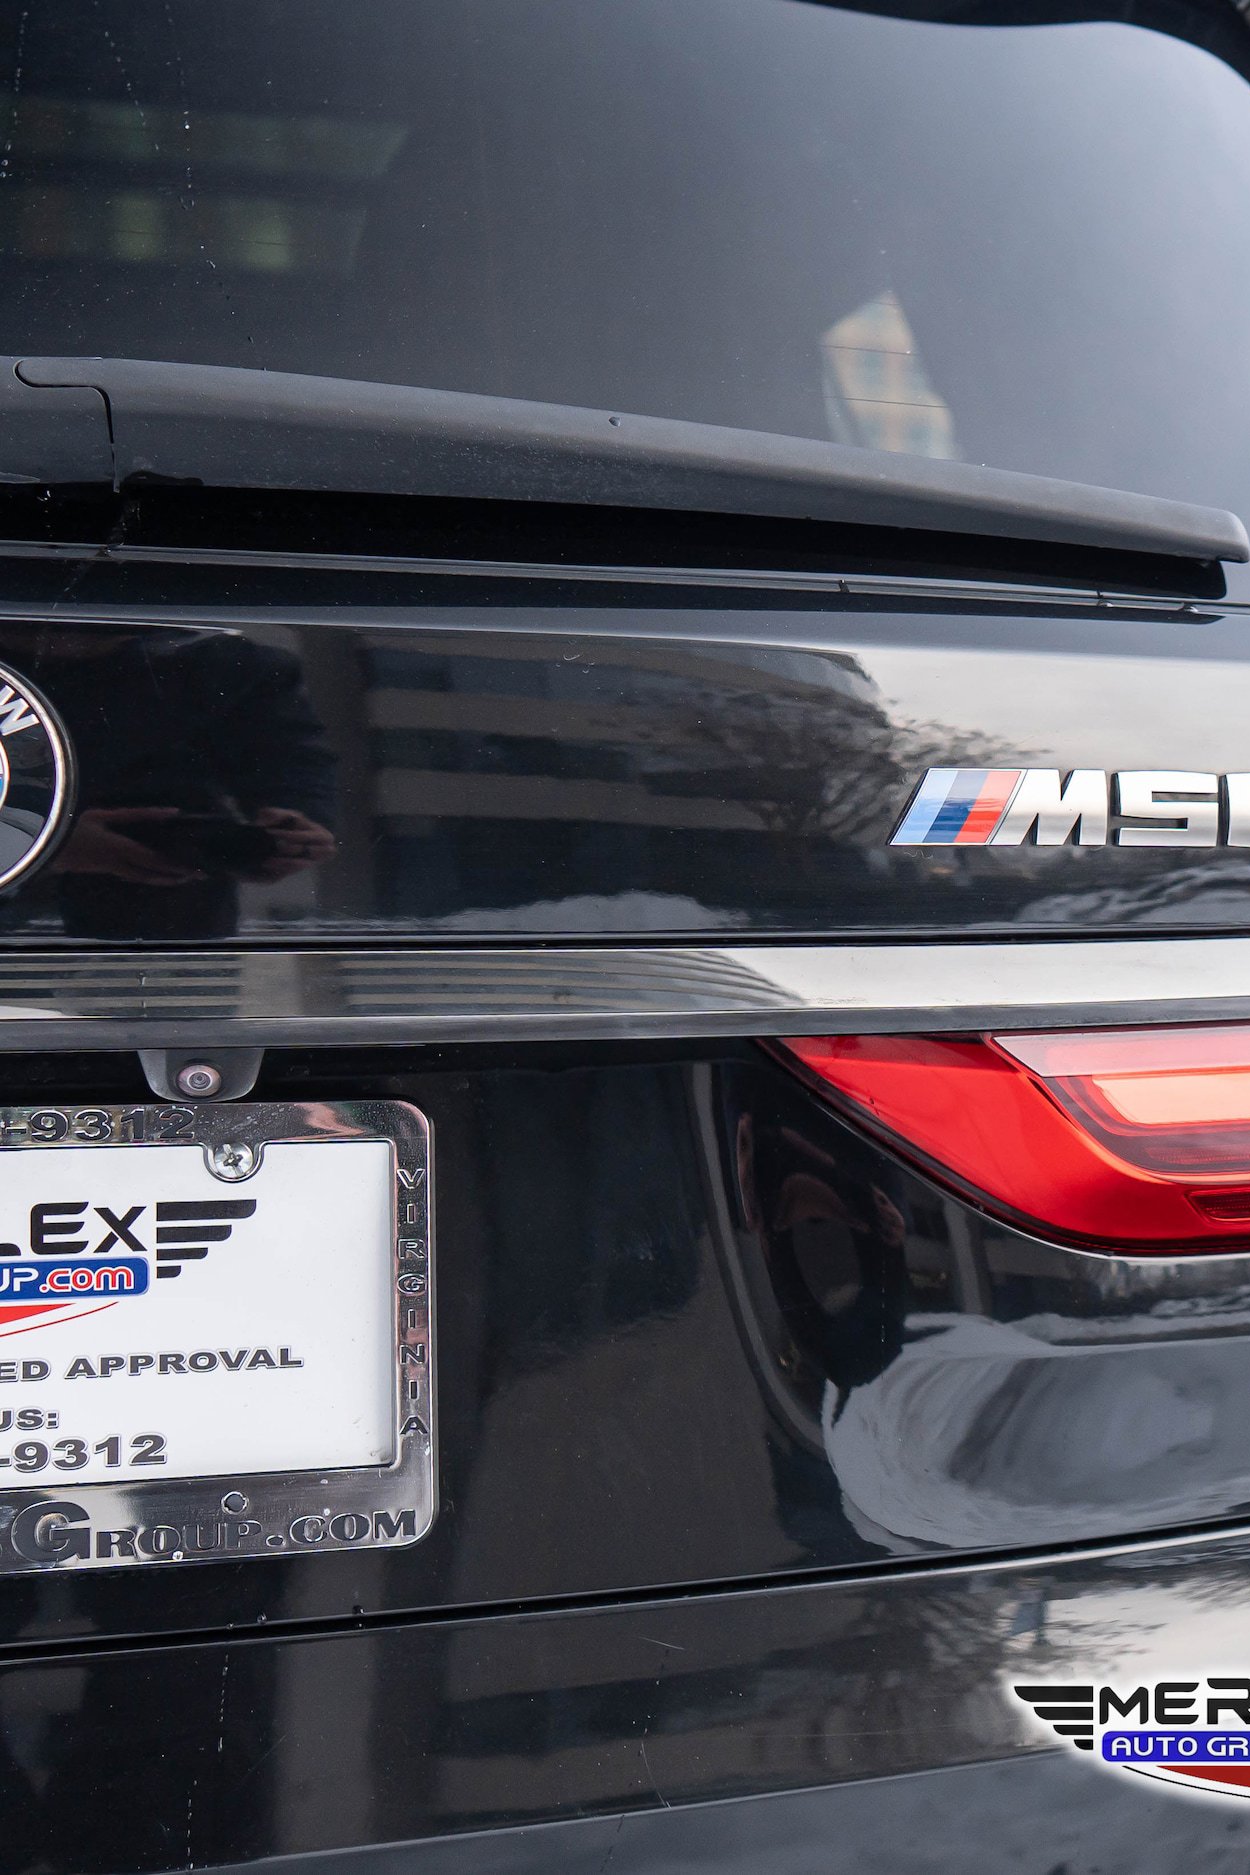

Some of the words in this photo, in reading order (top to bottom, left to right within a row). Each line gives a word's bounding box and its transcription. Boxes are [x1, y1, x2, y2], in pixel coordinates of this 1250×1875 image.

[0, 1201, 148, 1256] EX
[396, 1168, 429, 1437] VIRGINIA
[64, 1345, 304, 1379] APPROVAL
